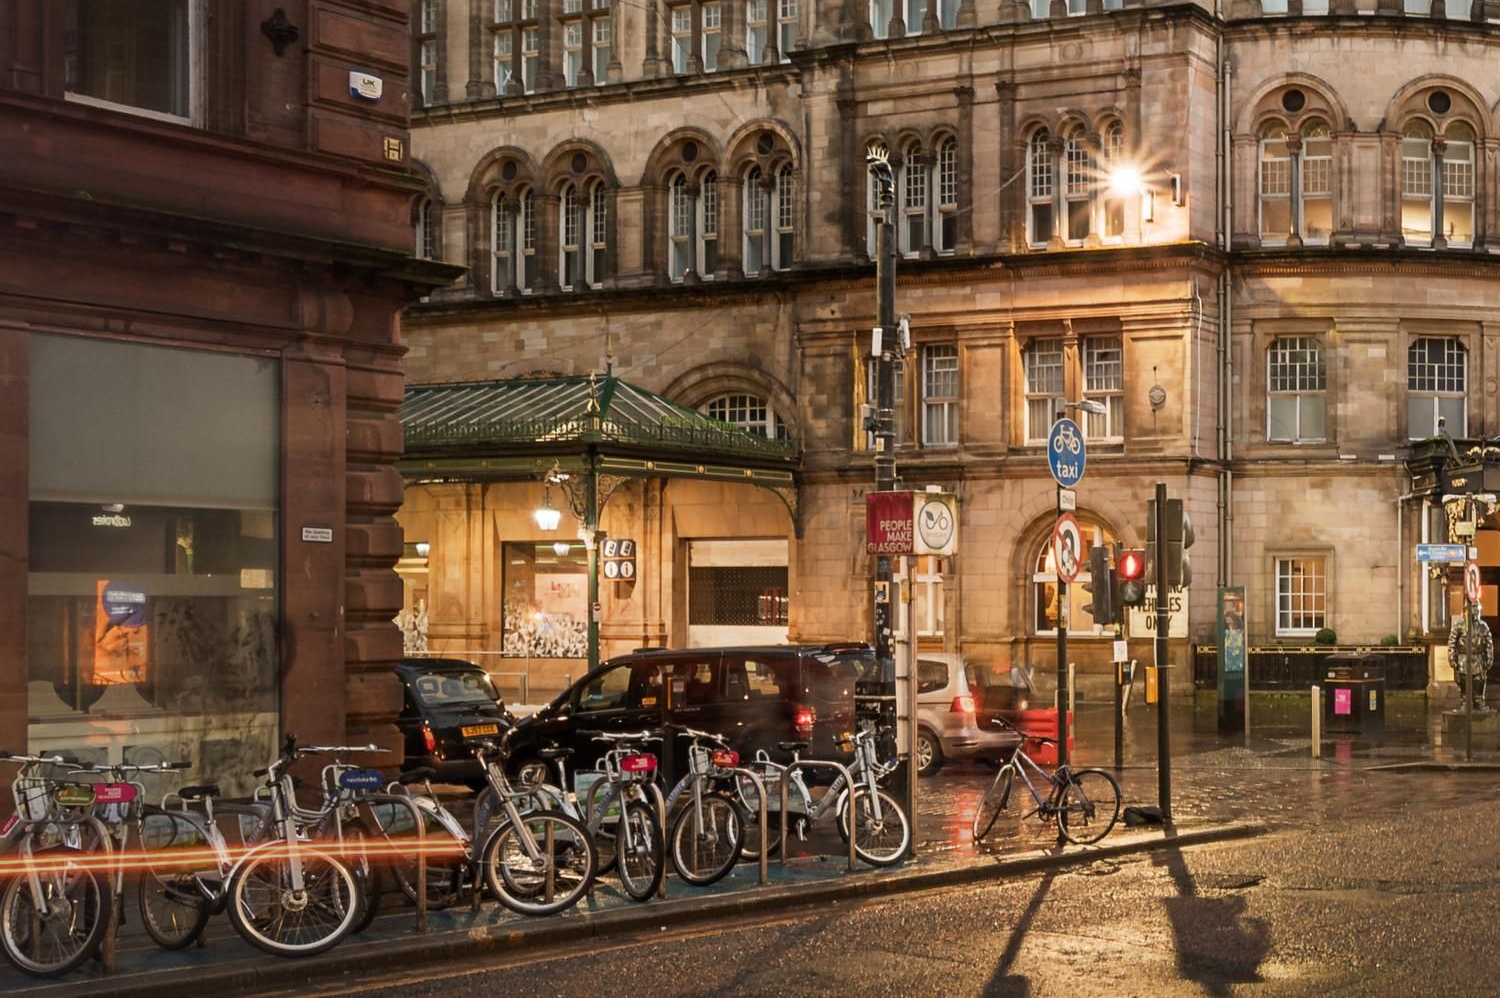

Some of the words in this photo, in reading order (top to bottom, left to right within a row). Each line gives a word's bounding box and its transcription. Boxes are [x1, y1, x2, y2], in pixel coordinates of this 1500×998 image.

[1056, 461, 1079, 479] taxi
[880, 520, 913, 531] PEOPLE
[886, 531, 913, 542] MAKE
[867, 542, 913, 553] GLASGOW
[1145, 615, 1172, 630] ONY
